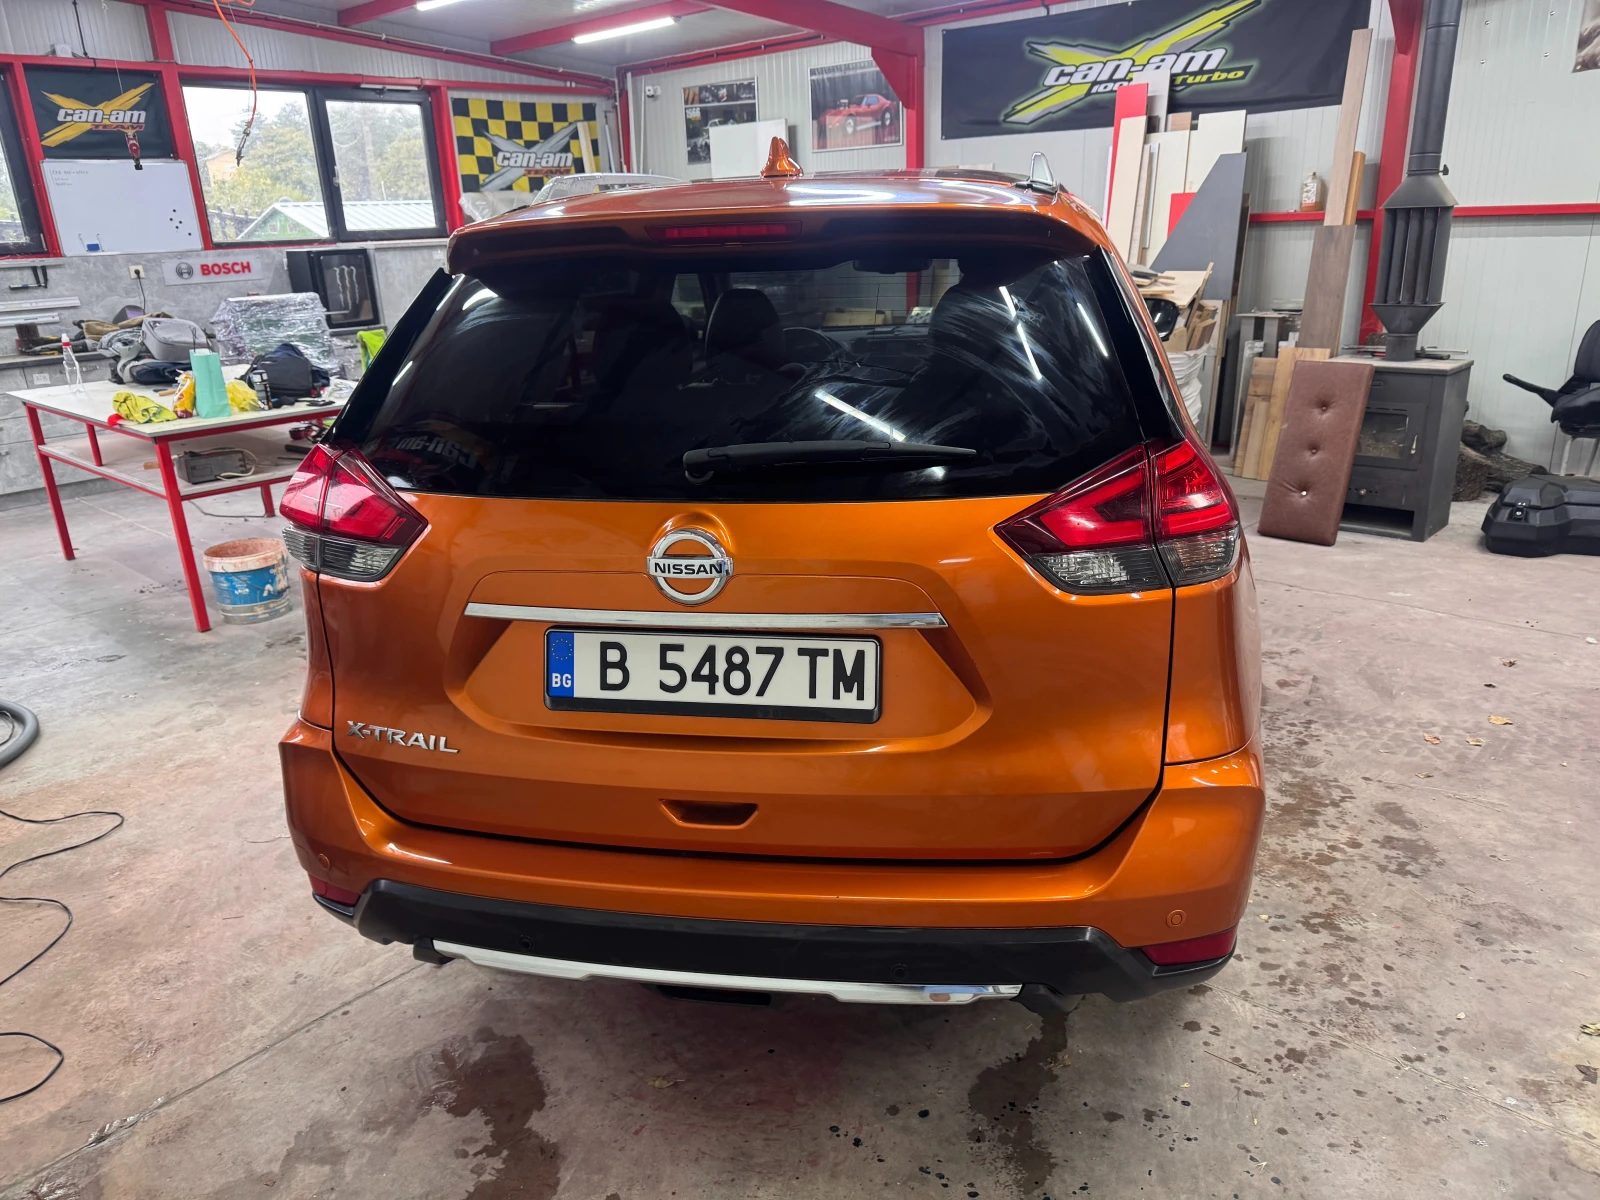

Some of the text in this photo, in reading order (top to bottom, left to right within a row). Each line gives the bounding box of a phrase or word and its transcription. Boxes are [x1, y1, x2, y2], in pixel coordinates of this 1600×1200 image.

[1043, 48, 1227, 86] can-am
[1173, 69, 1245, 85] Turbo
[57, 108, 146, 123] can-am
[91, 123, 146, 131] TEAM
[497, 152, 573, 167] can-am
[525, 168, 572, 177] TEAM
[200, 261, 252, 276] BOSCH
[654, 562, 723, 575] NISSAN
[600, 641, 866, 701] B 5487 TM
[552, 673, 572, 688] BG
[347, 720, 460, 753] X-TRAIL
